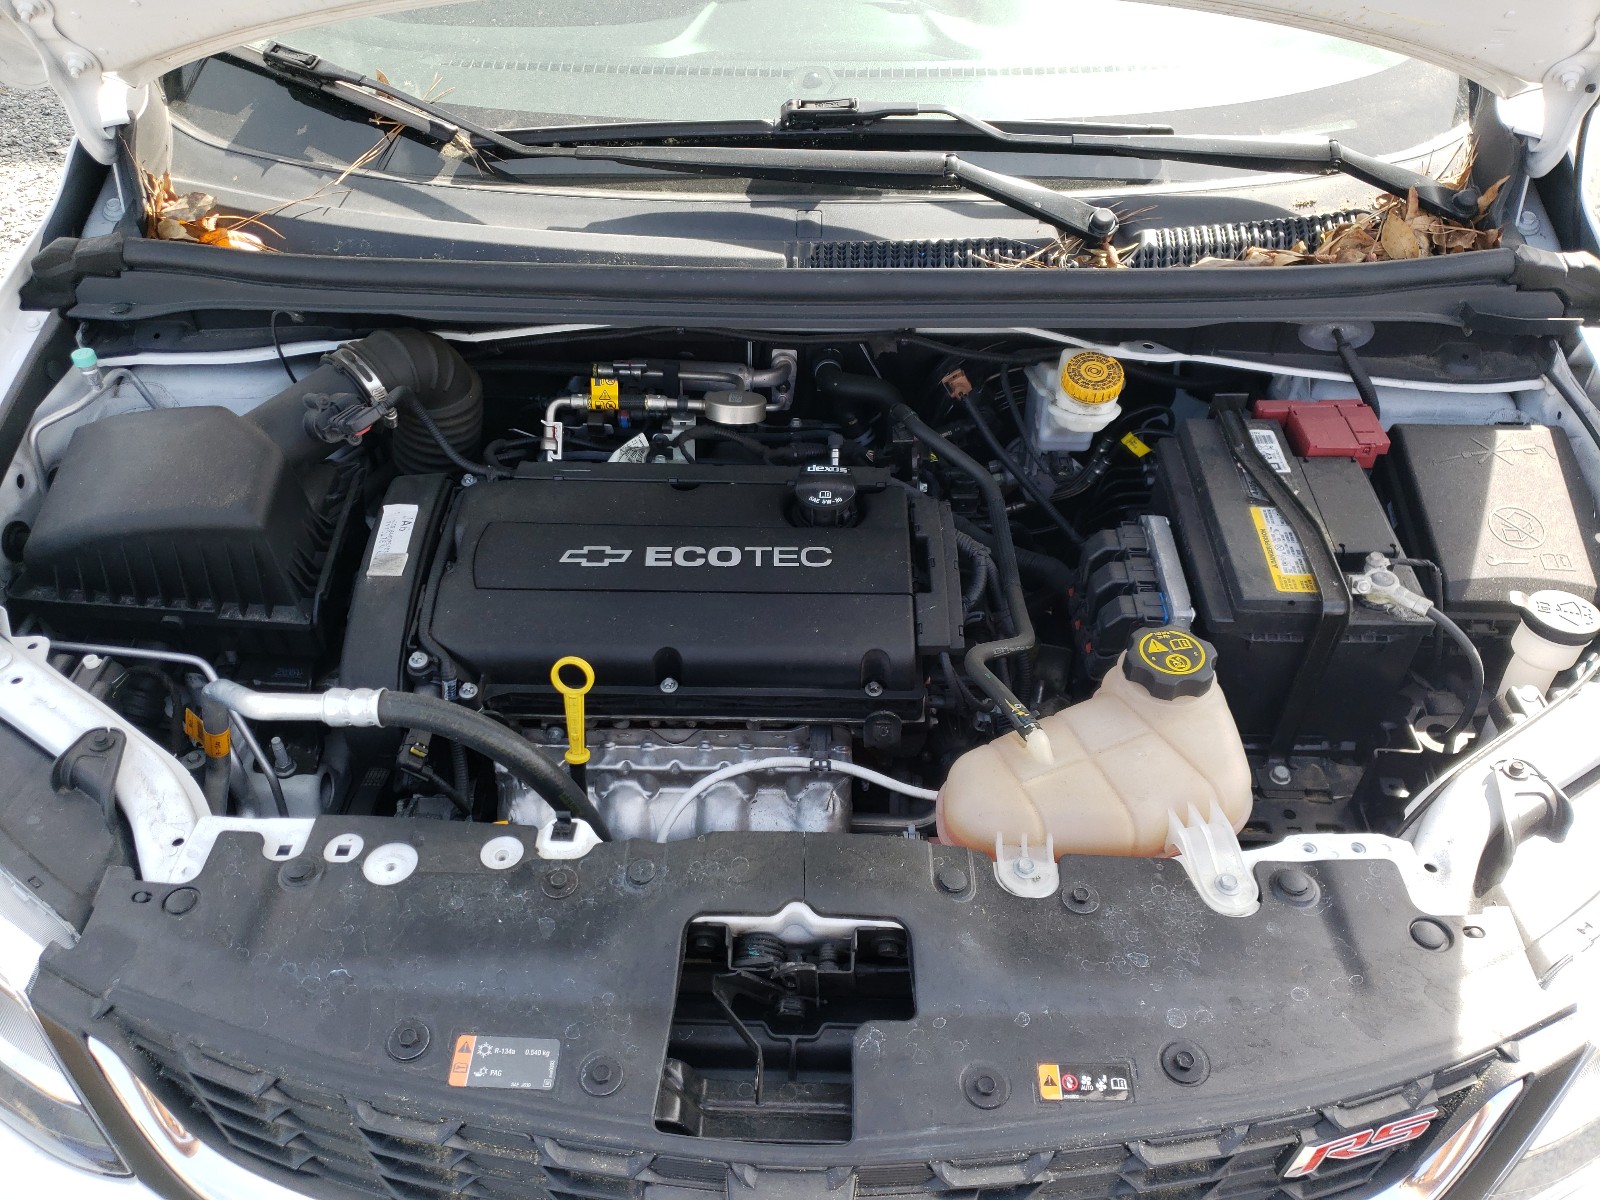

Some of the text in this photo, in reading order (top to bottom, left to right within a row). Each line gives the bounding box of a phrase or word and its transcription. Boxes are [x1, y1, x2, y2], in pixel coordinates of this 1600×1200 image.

[807, 465, 848, 473] dexos
[644, 546, 833, 568] ECOTEC
[542, 1050, 551, 1058] kg
[1295, 1109, 1440, 1174] RS
